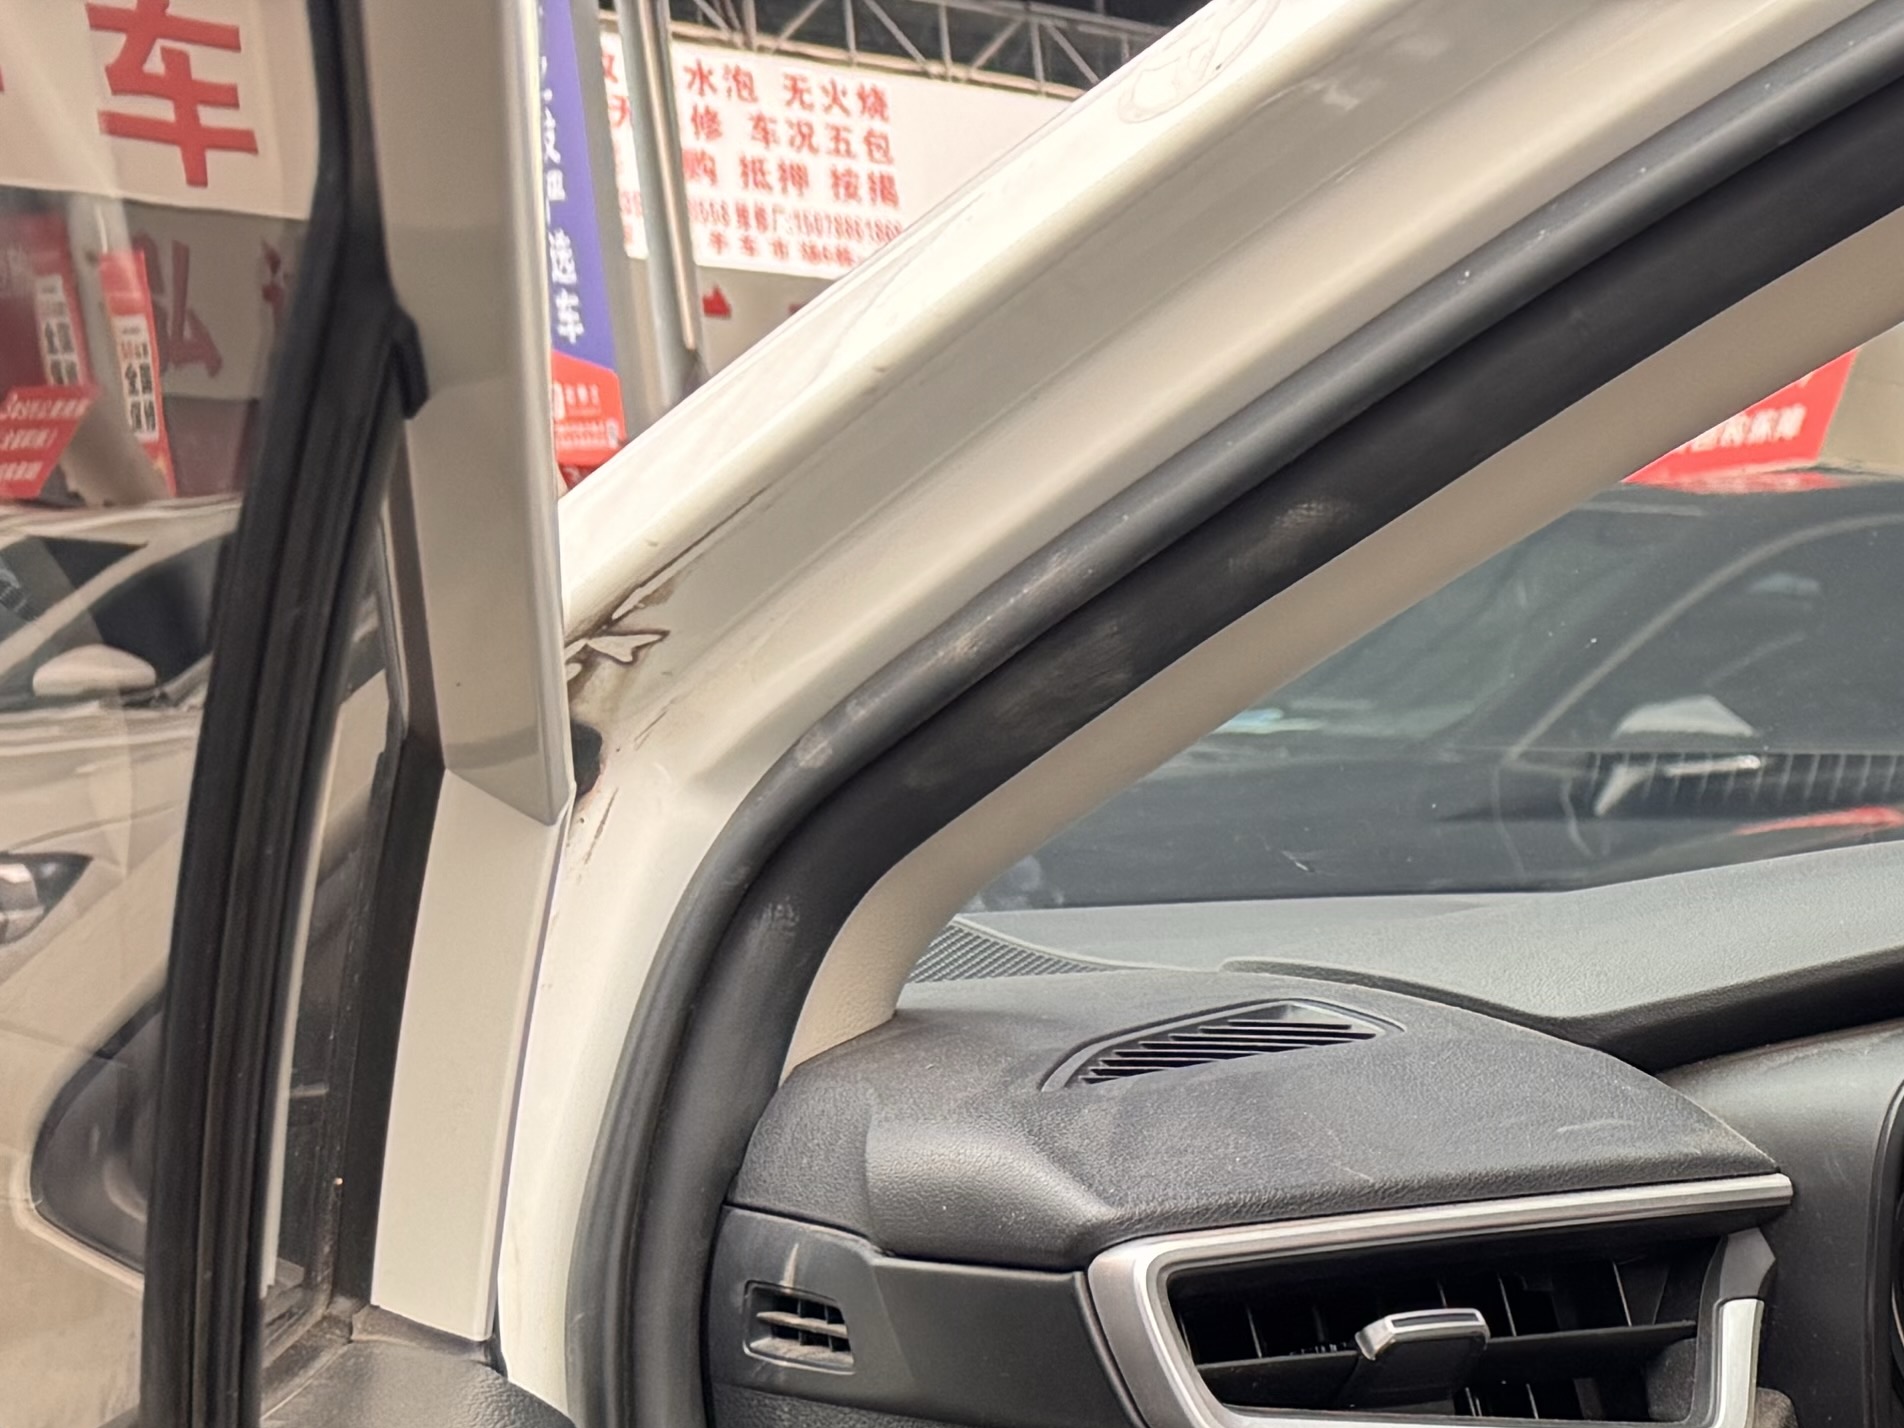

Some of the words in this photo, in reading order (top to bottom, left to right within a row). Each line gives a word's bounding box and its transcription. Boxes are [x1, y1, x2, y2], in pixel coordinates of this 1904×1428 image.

[85, 0, 258, 188] 车
[683, 60, 758, 104] 水泡
[783, 72, 890, 122] 无火烧
[749, 112, 894, 165] 车况五包
